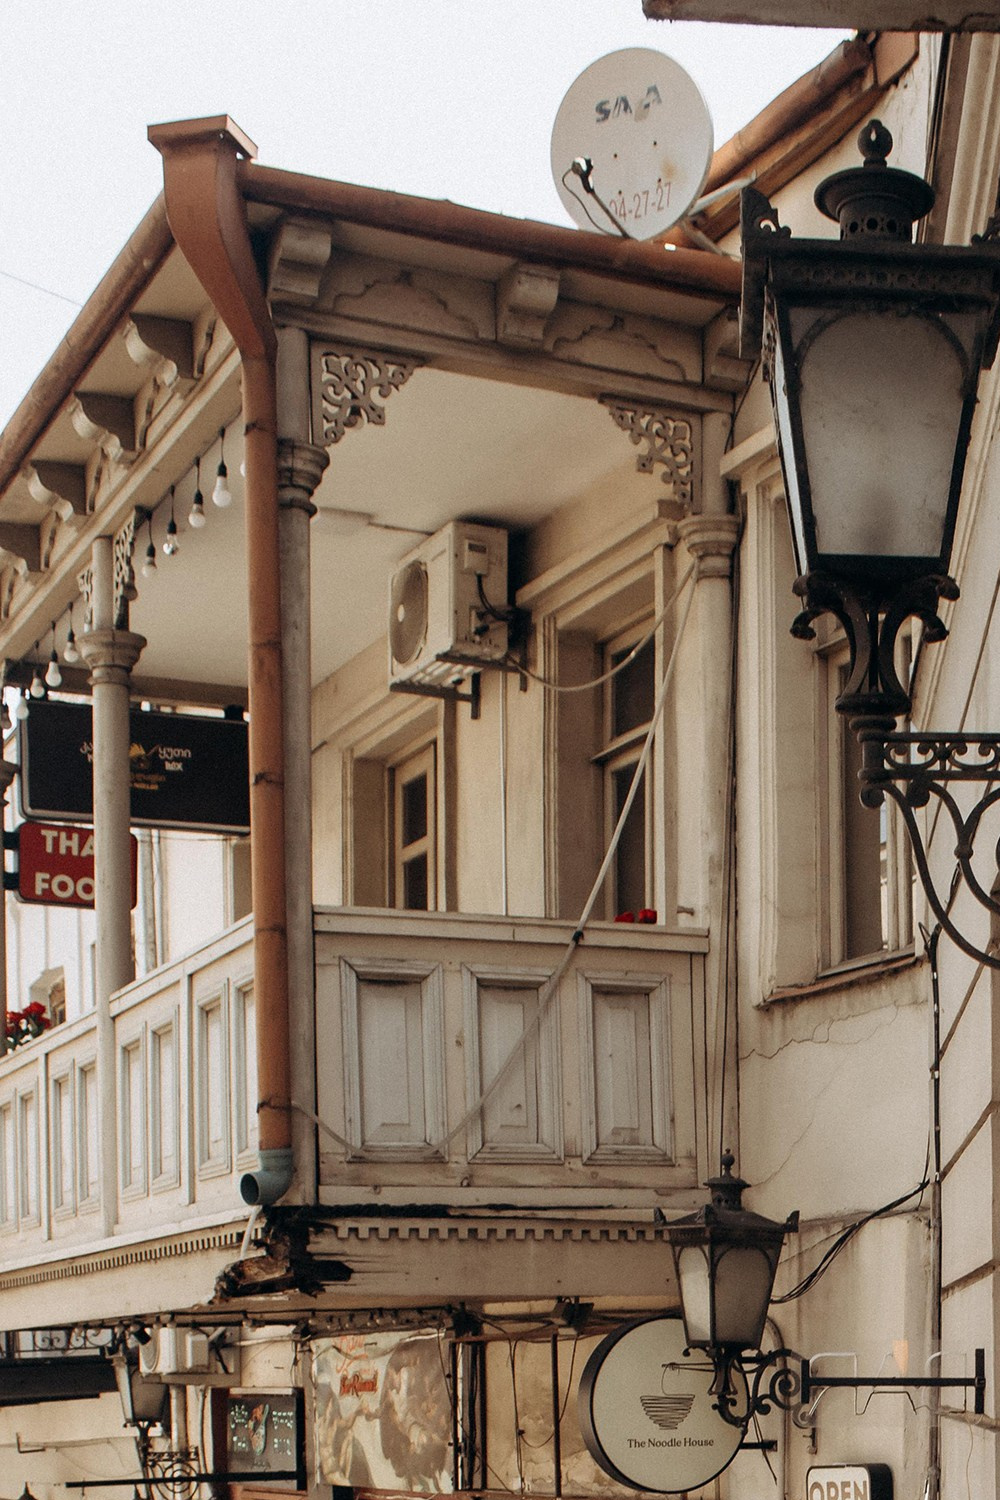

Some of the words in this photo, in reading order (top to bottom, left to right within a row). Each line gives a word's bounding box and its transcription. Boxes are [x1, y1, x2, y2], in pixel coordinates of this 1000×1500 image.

[41, 829, 94, 857] THA
[35, 872, 95, 901] FOO
[627, 1438, 646, 1448] The
[648, 1437, 681, 1447] Noodle
[683, 1437, 714, 1447] House
